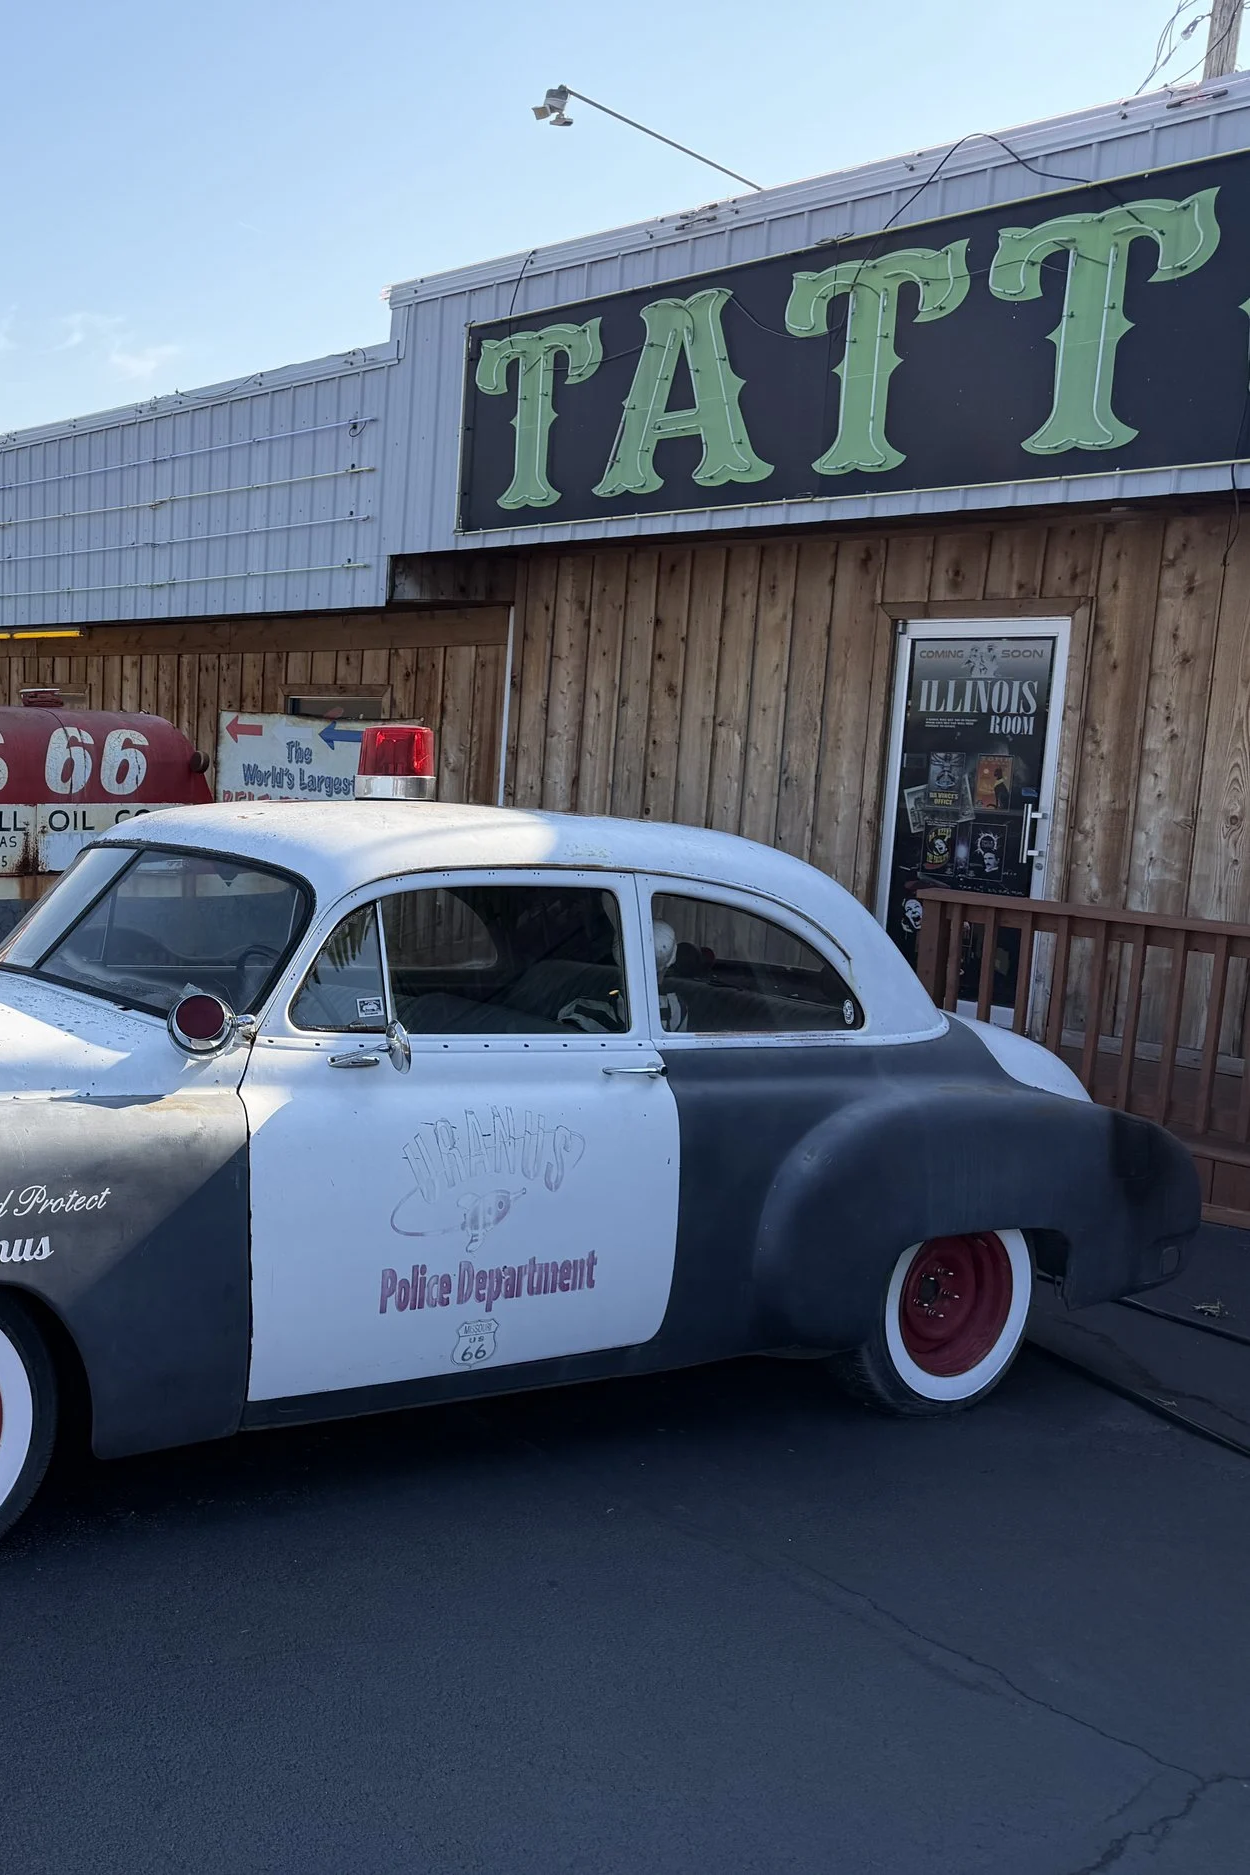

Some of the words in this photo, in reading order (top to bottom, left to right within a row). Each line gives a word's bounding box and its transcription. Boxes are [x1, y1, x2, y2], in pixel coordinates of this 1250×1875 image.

[475, 186, 1250, 510] TATT
[919, 650, 964, 659] COMING
[1001, 649, 1044, 658] SOON
[918, 680, 1038, 714] ILLINOIS
[990, 715, 1035, 735] ROOM
[44, 726, 150, 795] 66
[286, 740, 313, 764] The
[242, 763, 295, 790] World's
[48, 810, 95, 832] OIL
[402, 1105, 572, 1204] URANUS
[13, 1185, 111, 1217] Protect
[379, 1264, 452, 1314] Police
[456, 1250, 598, 1313] Department
[463, 1323, 493, 1335] MISSOURI
[468, 1335, 485, 1344] US
[461, 1344, 487, 1362] 66
